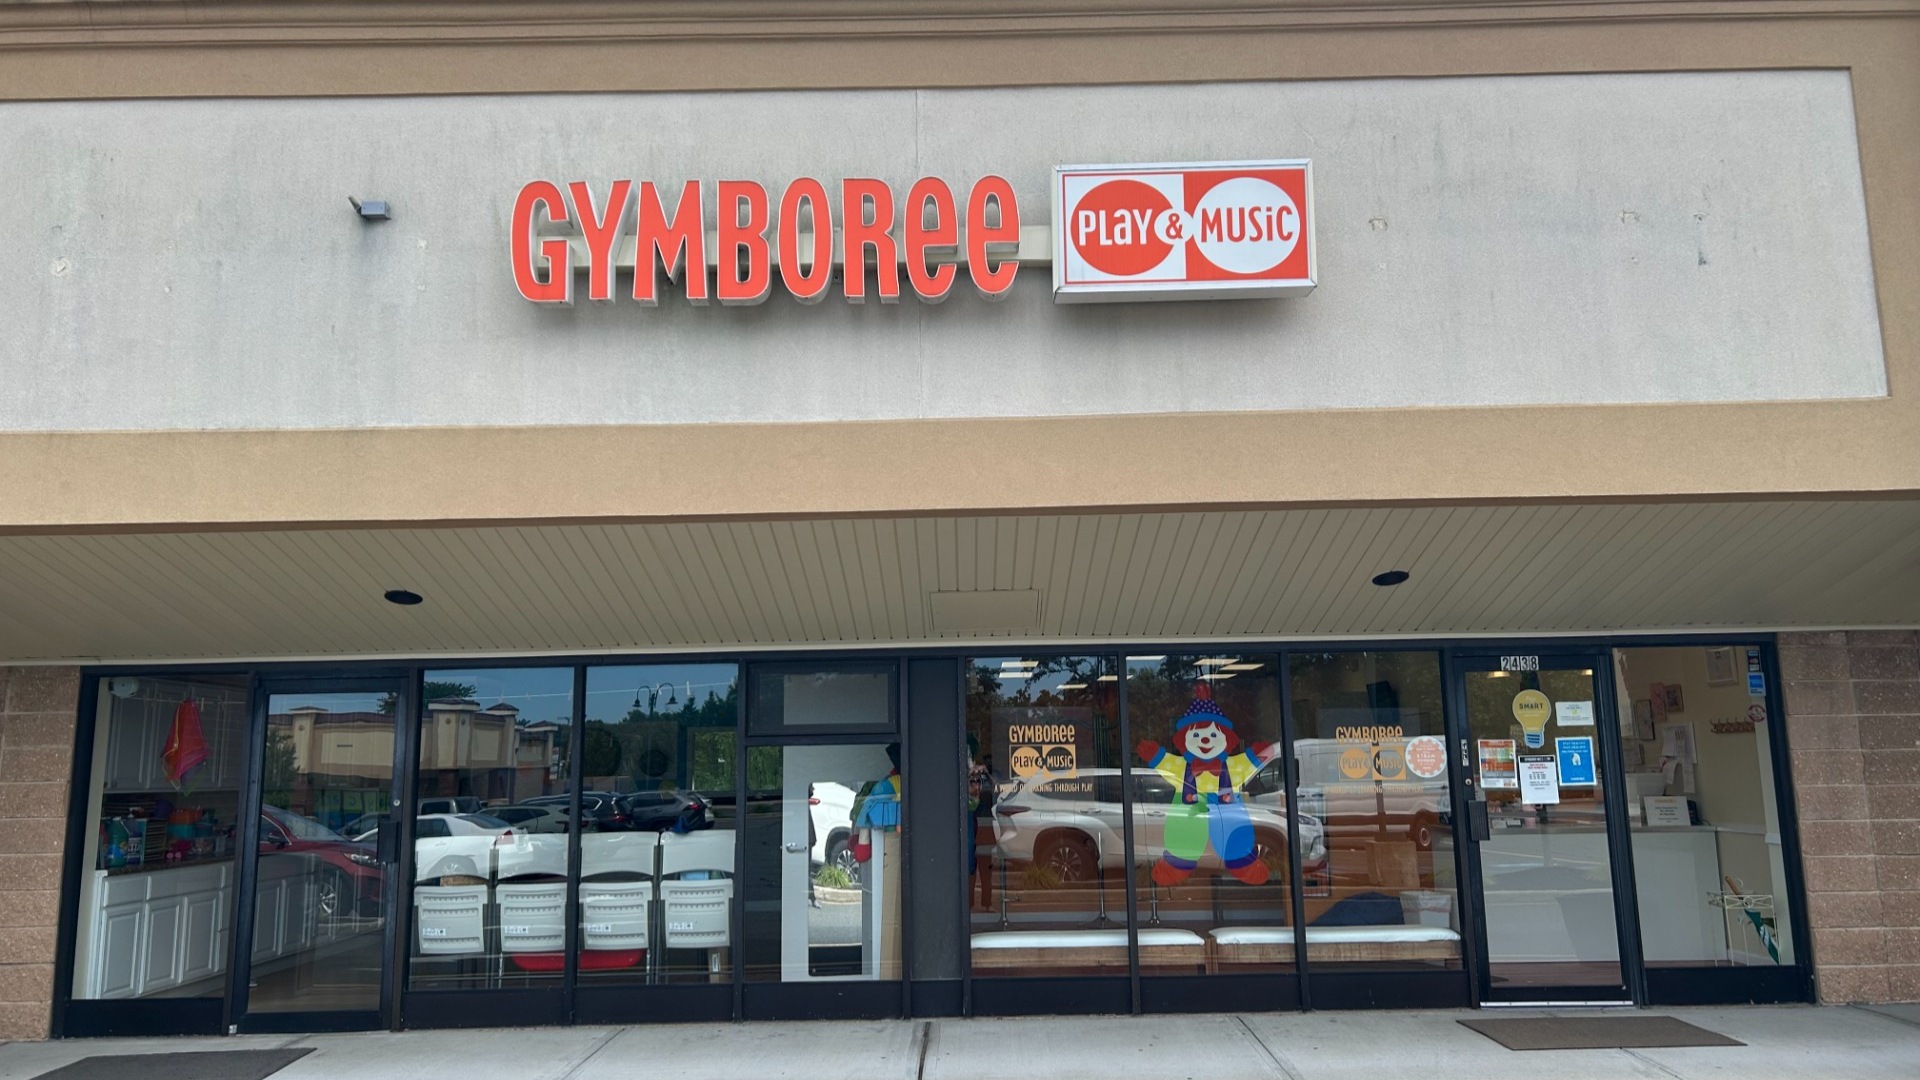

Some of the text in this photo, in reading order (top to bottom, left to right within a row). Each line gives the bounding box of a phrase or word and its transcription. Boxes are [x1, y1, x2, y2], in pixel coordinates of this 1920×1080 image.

[1165, 212, 1183, 240] &
[1502, 656, 1539, 671] 2438
[1519, 702, 1543, 710] SMART
[1054, 783, 1080, 792] THROUGH
[1081, 783, 1094, 792] PLAY
